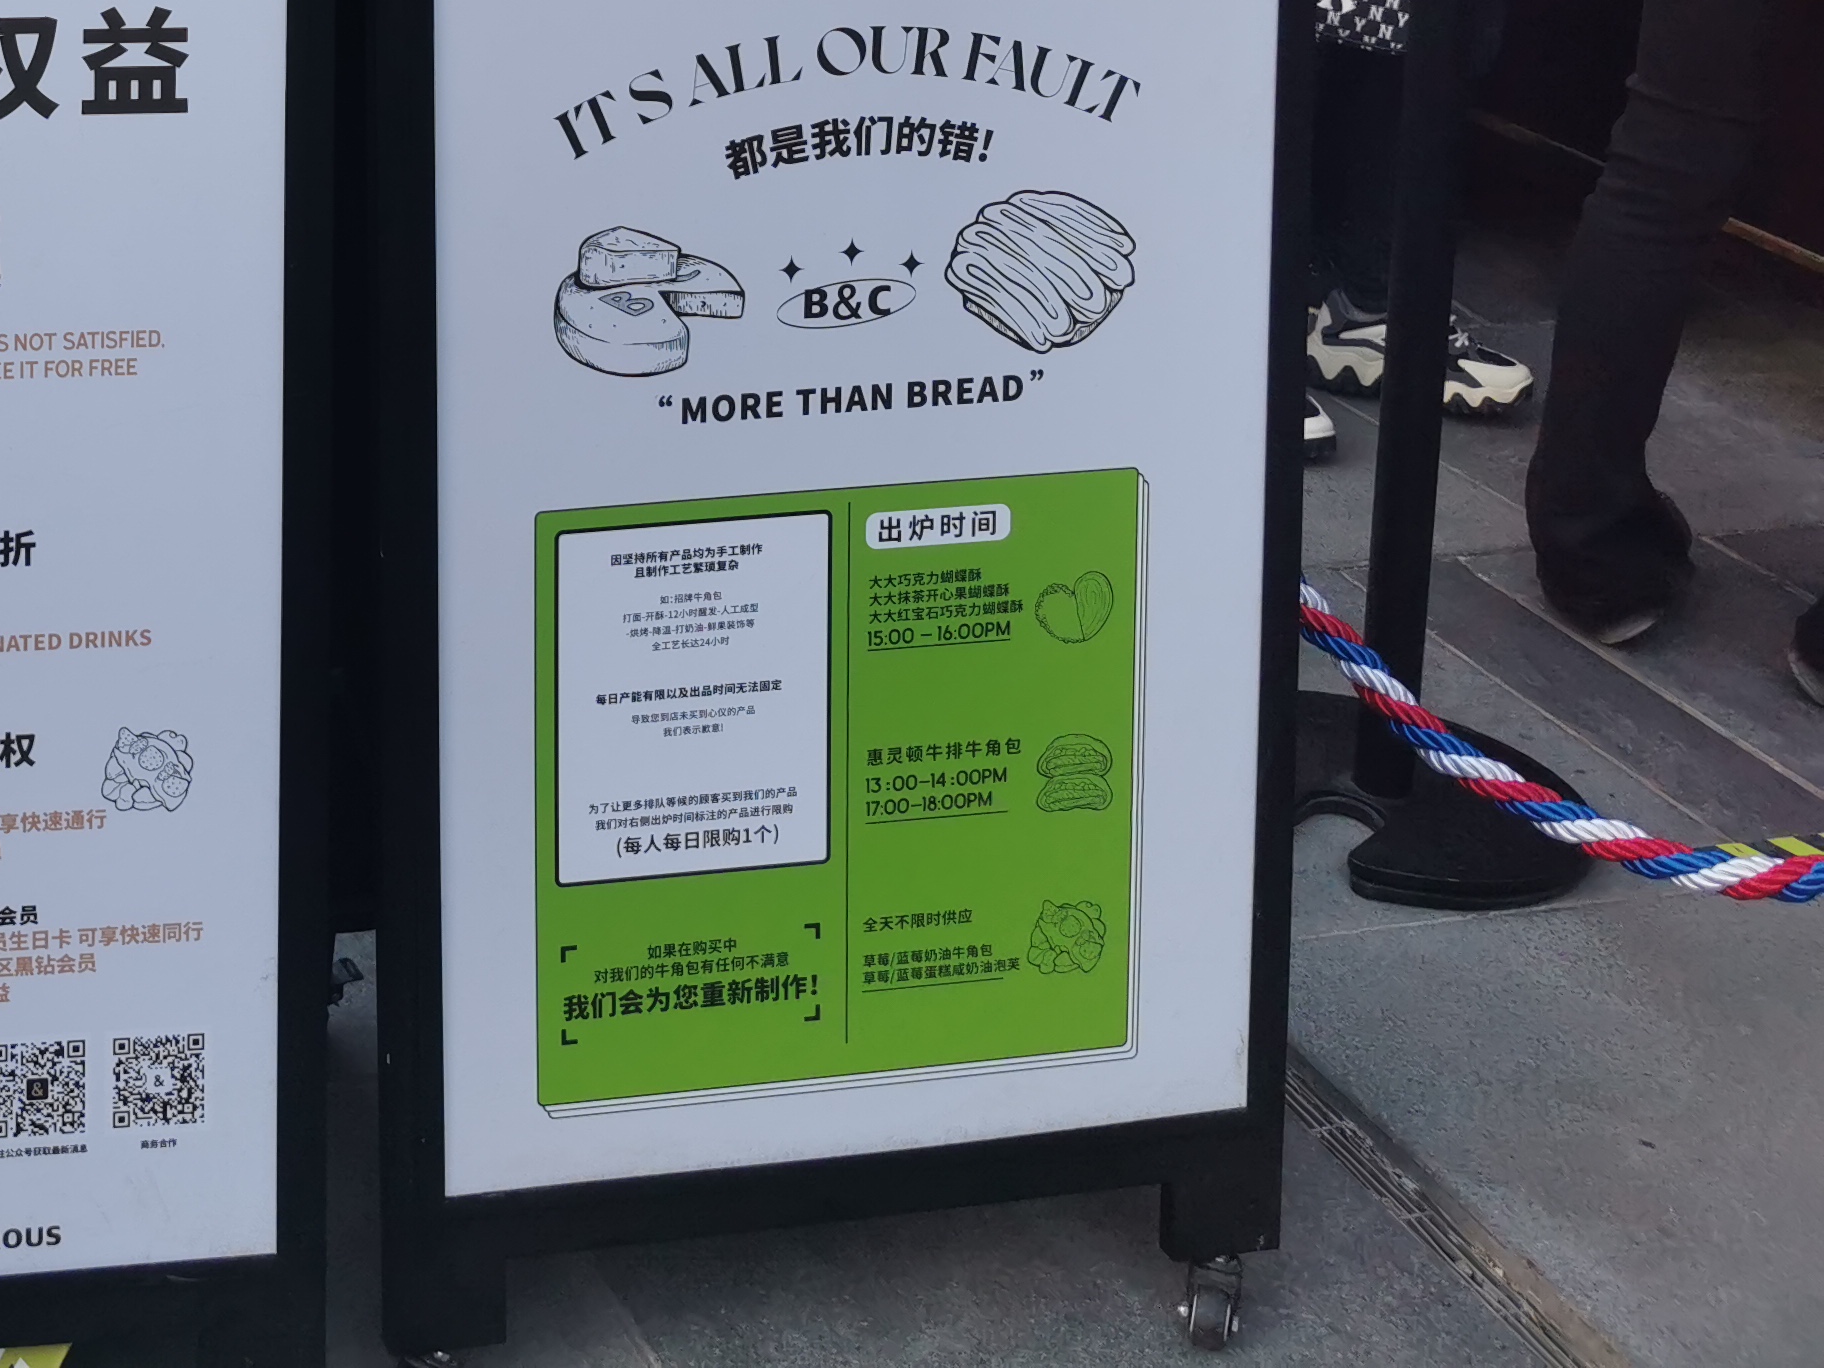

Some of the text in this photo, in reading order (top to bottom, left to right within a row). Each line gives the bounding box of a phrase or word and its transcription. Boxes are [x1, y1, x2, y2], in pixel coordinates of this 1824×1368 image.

[688, 34, 803, 107] ALL
[816, 26, 949, 78] OUR
[960, 31, 1141, 123] FAULT
[725, 116, 994, 180] 都是我们的错!
[803, 283, 892, 320] B&C
[14, 333, 57, 351] NOT
[20, 361, 38, 378] IT
[44, 360, 83, 378] FOR
[89, 358, 137, 376] FREE
[796, 383, 892, 415] THAN
[879, 511, 996, 542] 出炉时间
[611, 543, 762, 566] 因坚持所有产品均为手工制作
[869, 568, 981, 589] 大大巧克力蝴蝶酥
[869, 583, 1009, 606] 大大抹茶开心果蝴蝶酥
[869, 600, 1023, 624] 大大红宝石巧克力蝴蝶酥
[69, 629, 151, 649] DRINKS
[596, 680, 781, 705] 每日产能有限以及出品时间无法固定
[867, 738, 1021, 766] 惠灵顿牛排牛角包
[589, 787, 797, 814] 为了让更多排队等候的顾客买到我们的产品
[617, 824, 778, 858] (每人每日限购1个)
[863, 909, 972, 932] 全天不限时供应
[77, 922, 203, 947] 可享快速同行
[647, 938, 736, 959] 如果在购买中
[594, 952, 788, 983] 对我们的牛角包有任何不满意
[564, 975, 817, 1021] 我们会为您重新制作!
